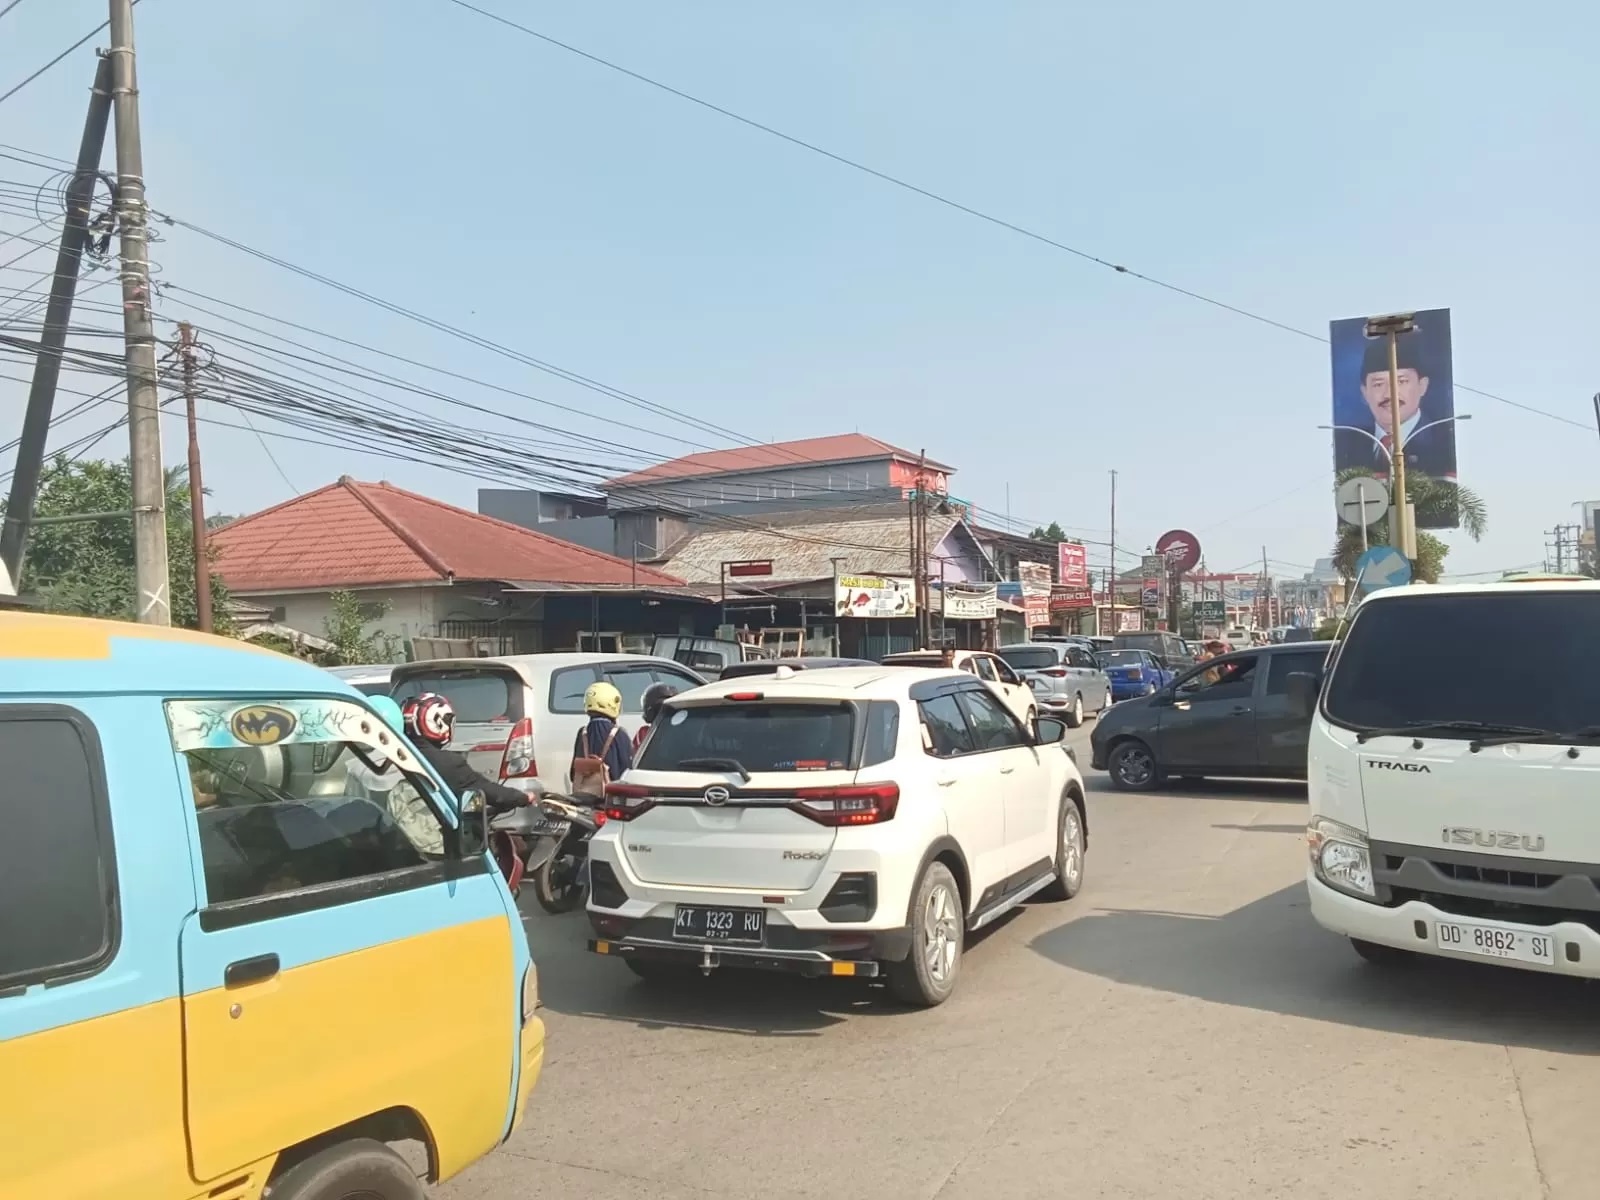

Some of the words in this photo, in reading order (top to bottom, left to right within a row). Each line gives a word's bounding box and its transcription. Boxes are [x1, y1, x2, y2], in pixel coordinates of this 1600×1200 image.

[1366, 760, 1431, 773] TRAGA
[1442, 827, 1545, 852] ISUZU
[677, 908, 695, 927] KT
[706, 911, 734, 929] 1323
[743, 912, 760, 931] RU
[1440, 924, 1461, 944] DD
[1474, 928, 1516, 951] 8862
[1531, 937, 1549, 957] SI
